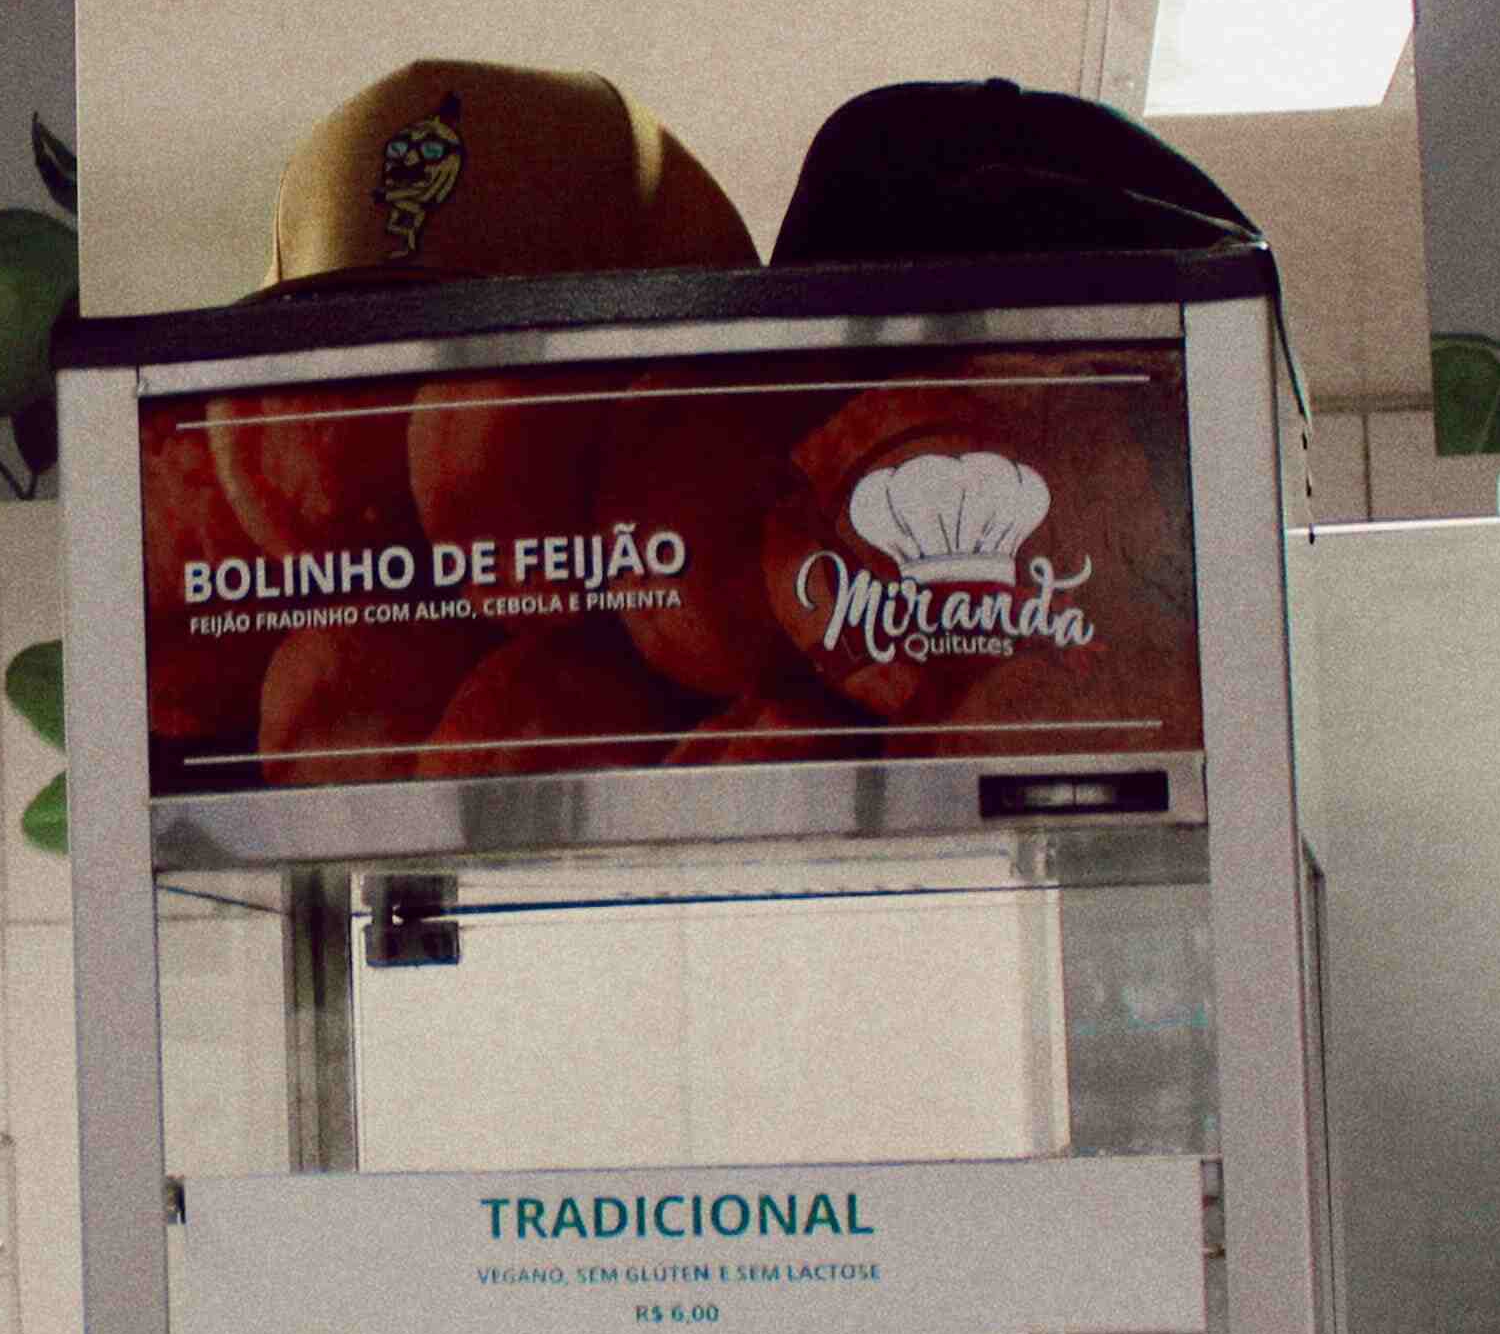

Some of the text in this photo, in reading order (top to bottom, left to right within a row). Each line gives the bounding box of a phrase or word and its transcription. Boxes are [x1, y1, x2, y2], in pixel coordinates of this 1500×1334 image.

[184, 523, 686, 603] BOLINHO DE FEIJÃO
[189, 589, 681, 638] FEIJÃO FRADINHO COM ALHO, CEBOLA E PIMENTA
[796, 550, 1094, 663] Miranda
[904, 633, 1014, 660] Quitutes
[480, 1192, 875, 1239] TRADICIONAL
[576, 1266, 620, 1285] SEM
[736, 1265, 782, 1283] SEM
[786, 1263, 881, 1283] LACTOSE
[635, 1304, 720, 1324] R$ 6,00
